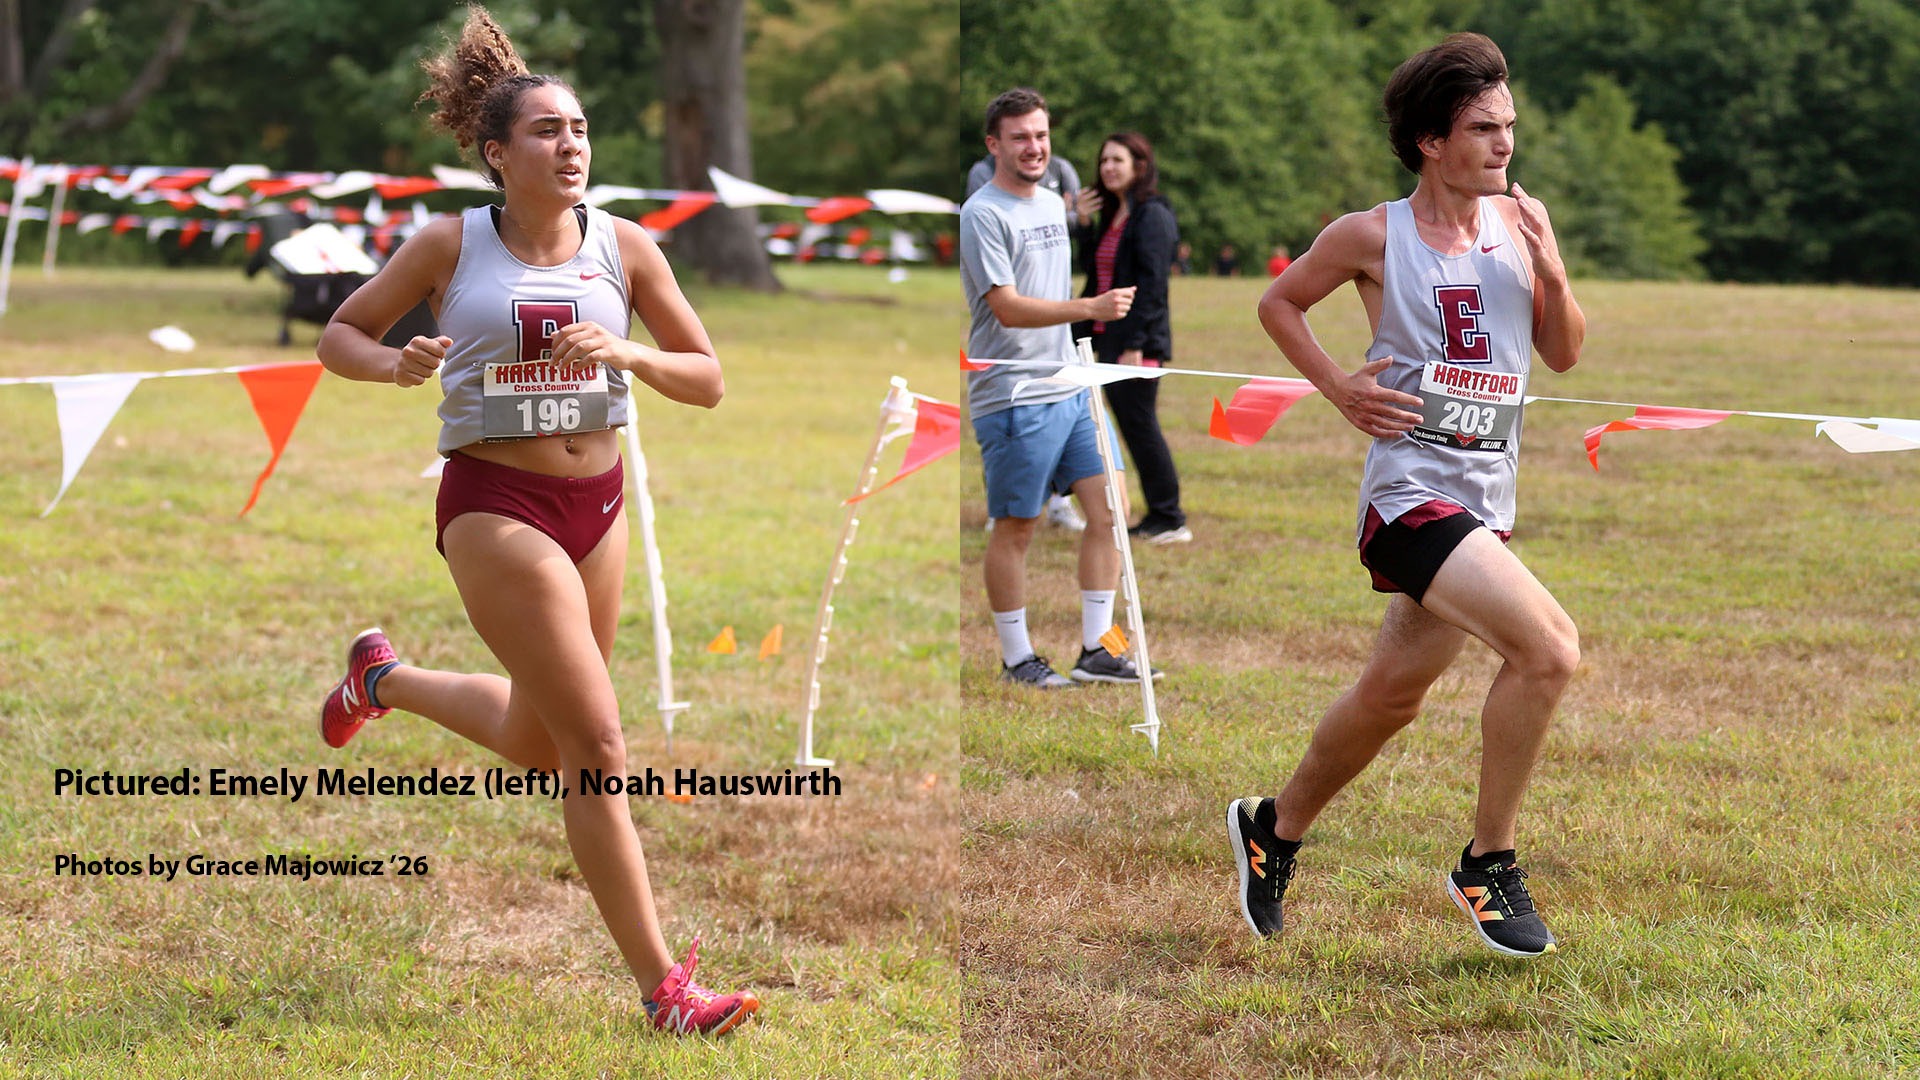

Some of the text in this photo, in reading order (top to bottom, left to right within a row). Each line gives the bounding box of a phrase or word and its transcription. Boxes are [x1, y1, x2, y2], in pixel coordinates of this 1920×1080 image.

[1433, 284, 1492, 364] E
[514, 383, 580, 393] Cross Country
[1433, 364, 1519, 395] HARTFORD
[1447, 387, 1503, 402] Cross Country
[517, 398, 581, 432] 196
[1439, 401, 1497, 436] 203
